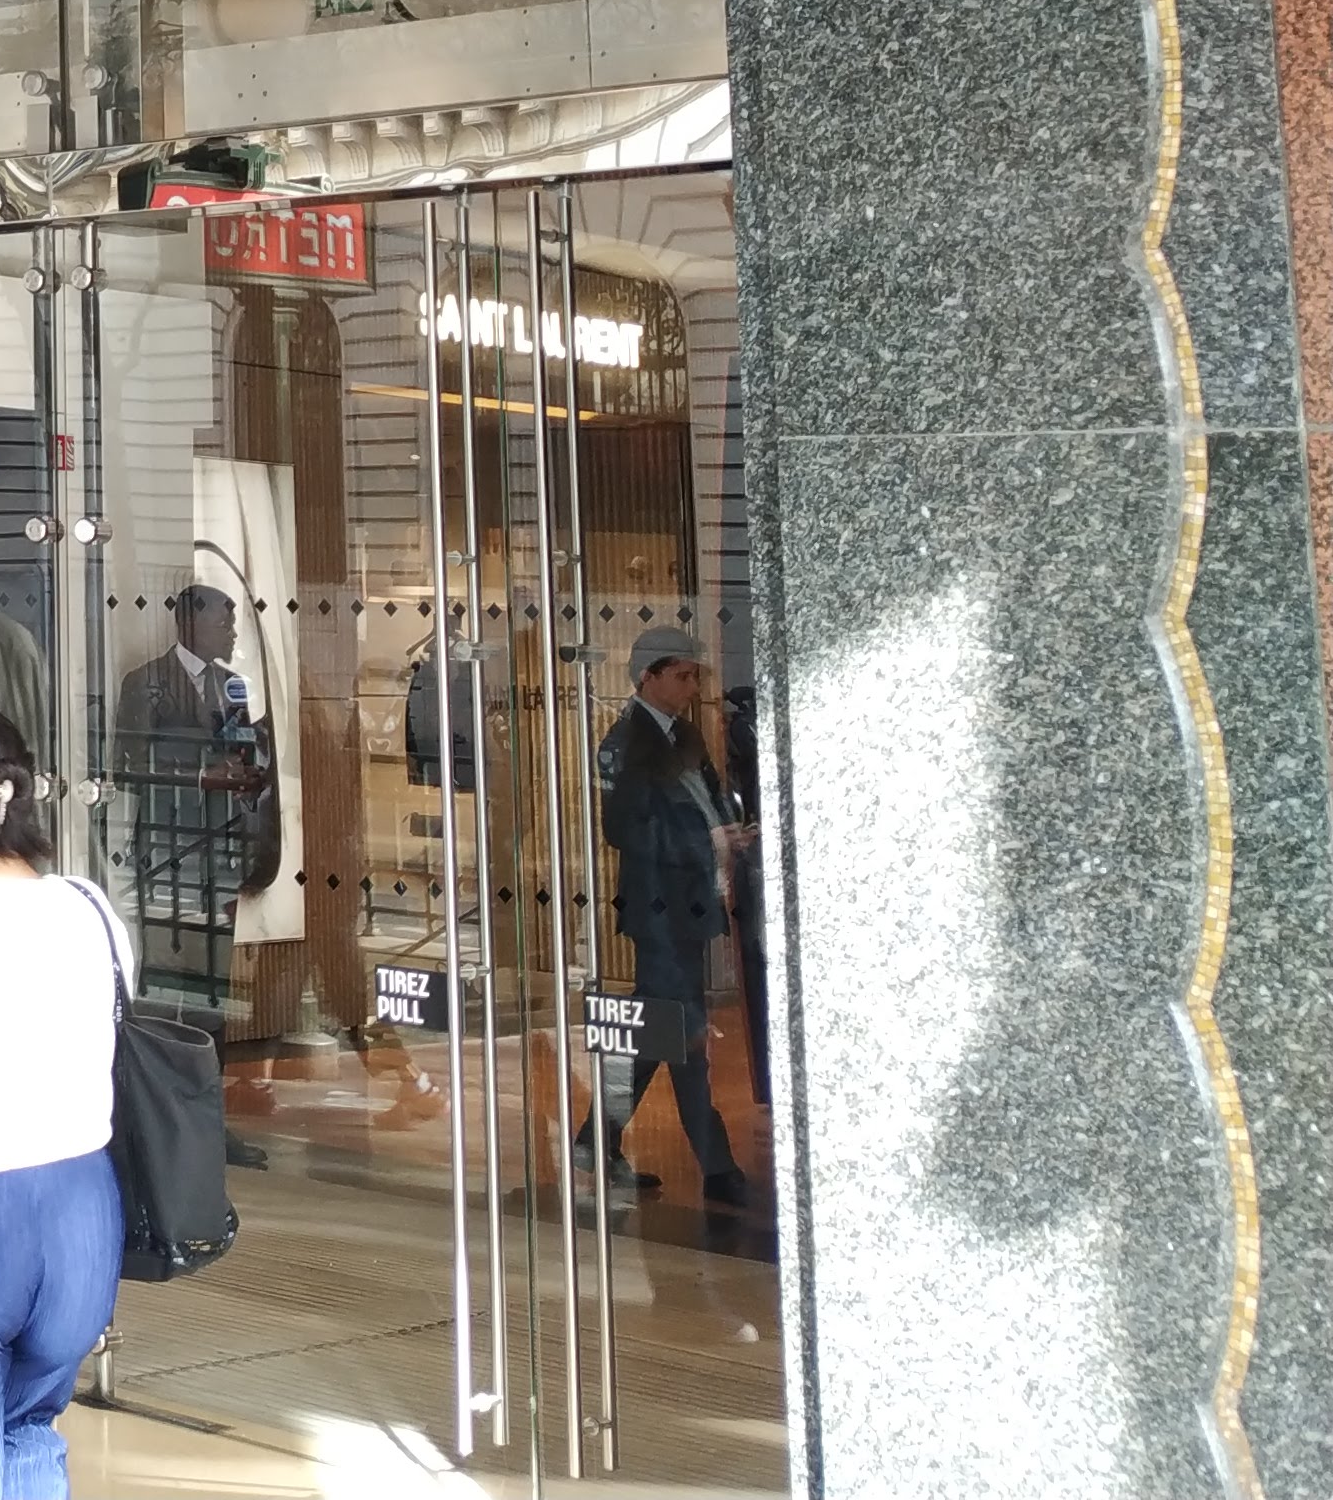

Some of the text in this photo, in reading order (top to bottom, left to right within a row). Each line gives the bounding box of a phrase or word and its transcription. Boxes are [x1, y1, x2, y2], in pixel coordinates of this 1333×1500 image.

[419, 291, 508, 349] SANT
[376, 967, 430, 998] TIREZ
[377, 995, 425, 1025] PULL
[585, 995, 645, 1027] TIREZ
[586, 1024, 639, 1056] PULL
